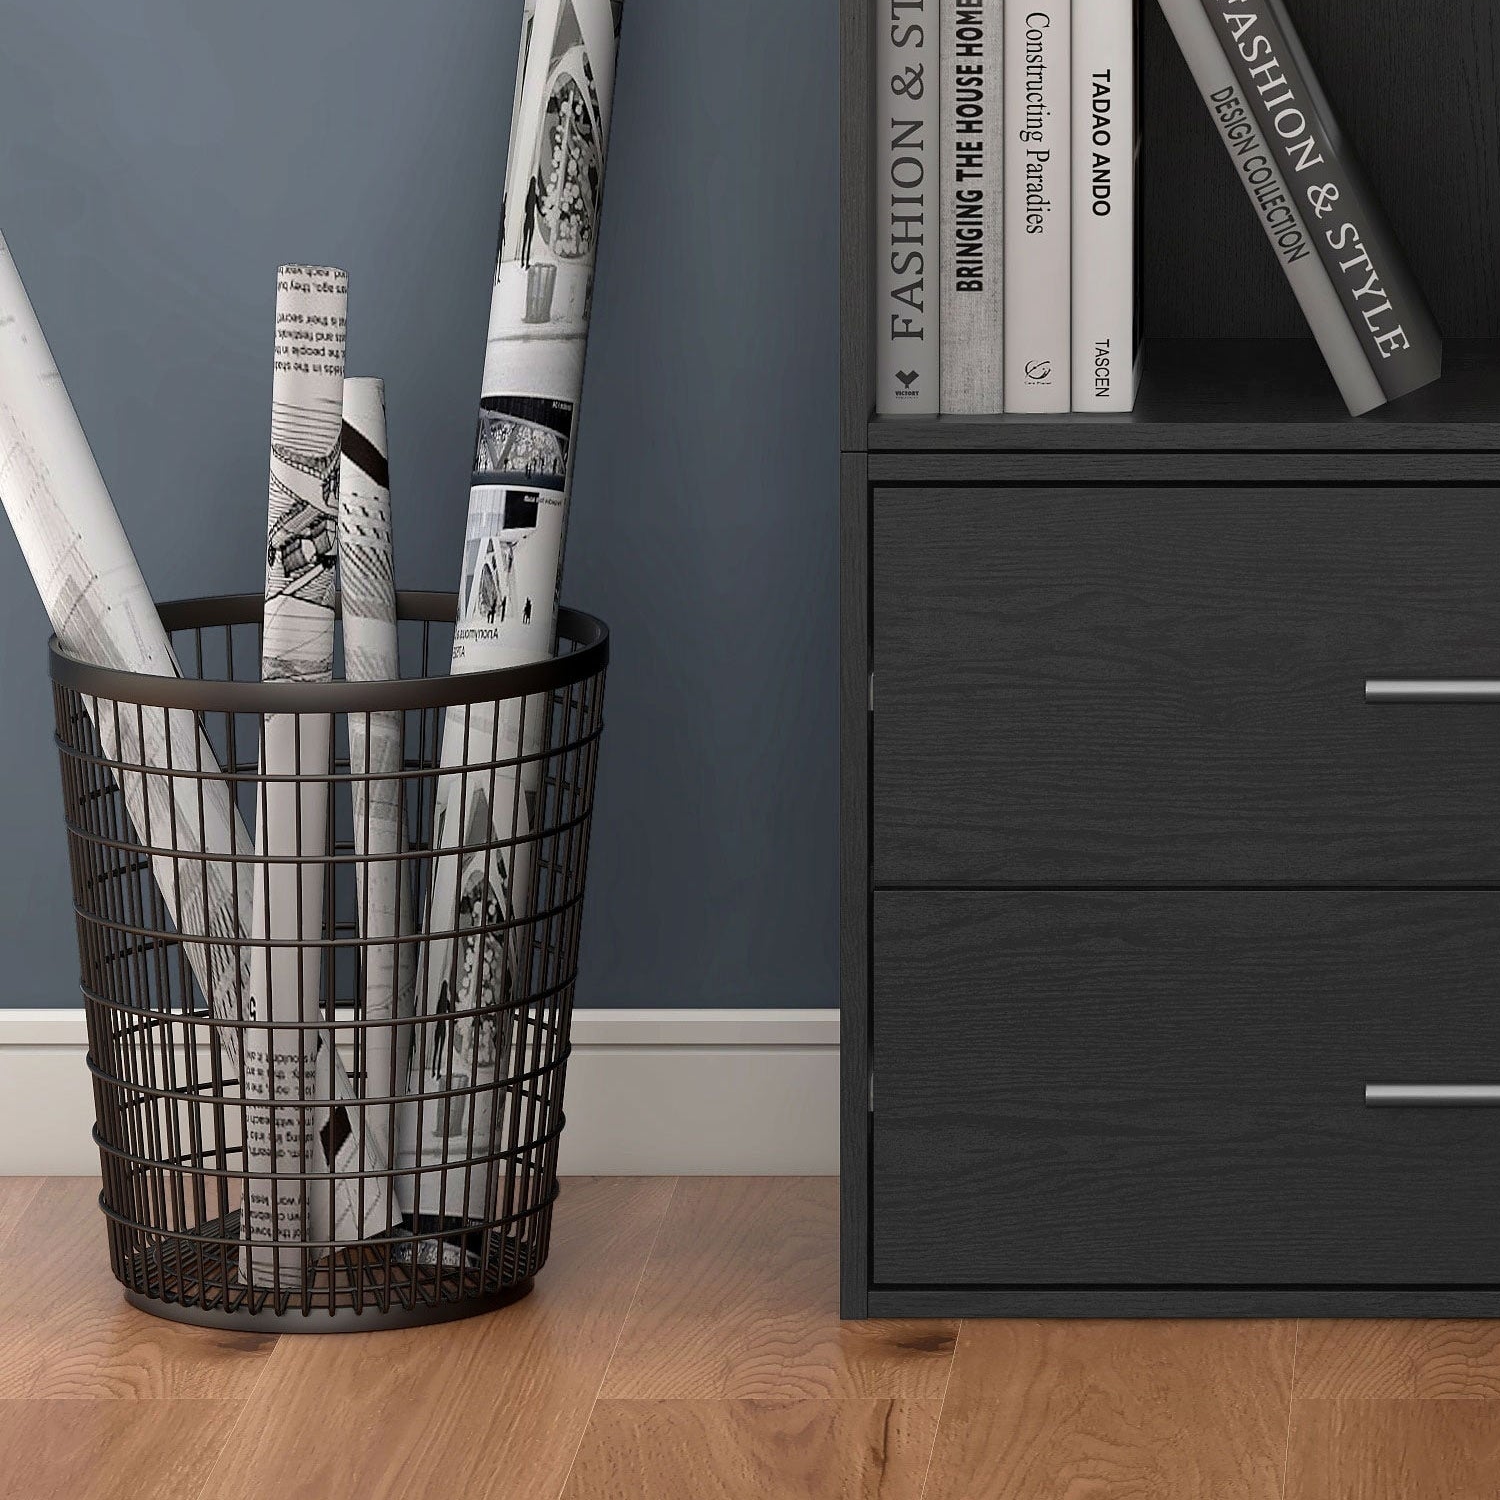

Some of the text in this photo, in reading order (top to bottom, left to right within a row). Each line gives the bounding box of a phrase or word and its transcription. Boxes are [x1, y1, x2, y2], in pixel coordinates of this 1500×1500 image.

[890, 62, 924, 101] &
[955, 64, 984, 134] HOUSE
[1019, 12, 1051, 235] Constructing Paradies
[955, 141, 984, 183] THE
[1092, 68, 1111, 217] TADAO ANDO
[1210, 86, 1310, 264] DESIGN COLLECTION
[890, 117, 924, 341] FASHION
[955, 189, 984, 292] BRINGING
[1306, 182, 1340, 219] &
[1325, 222, 1410, 359] STYLE
[292, 345, 326, 358] people
[1094, 338, 1110, 397] TASCEN
